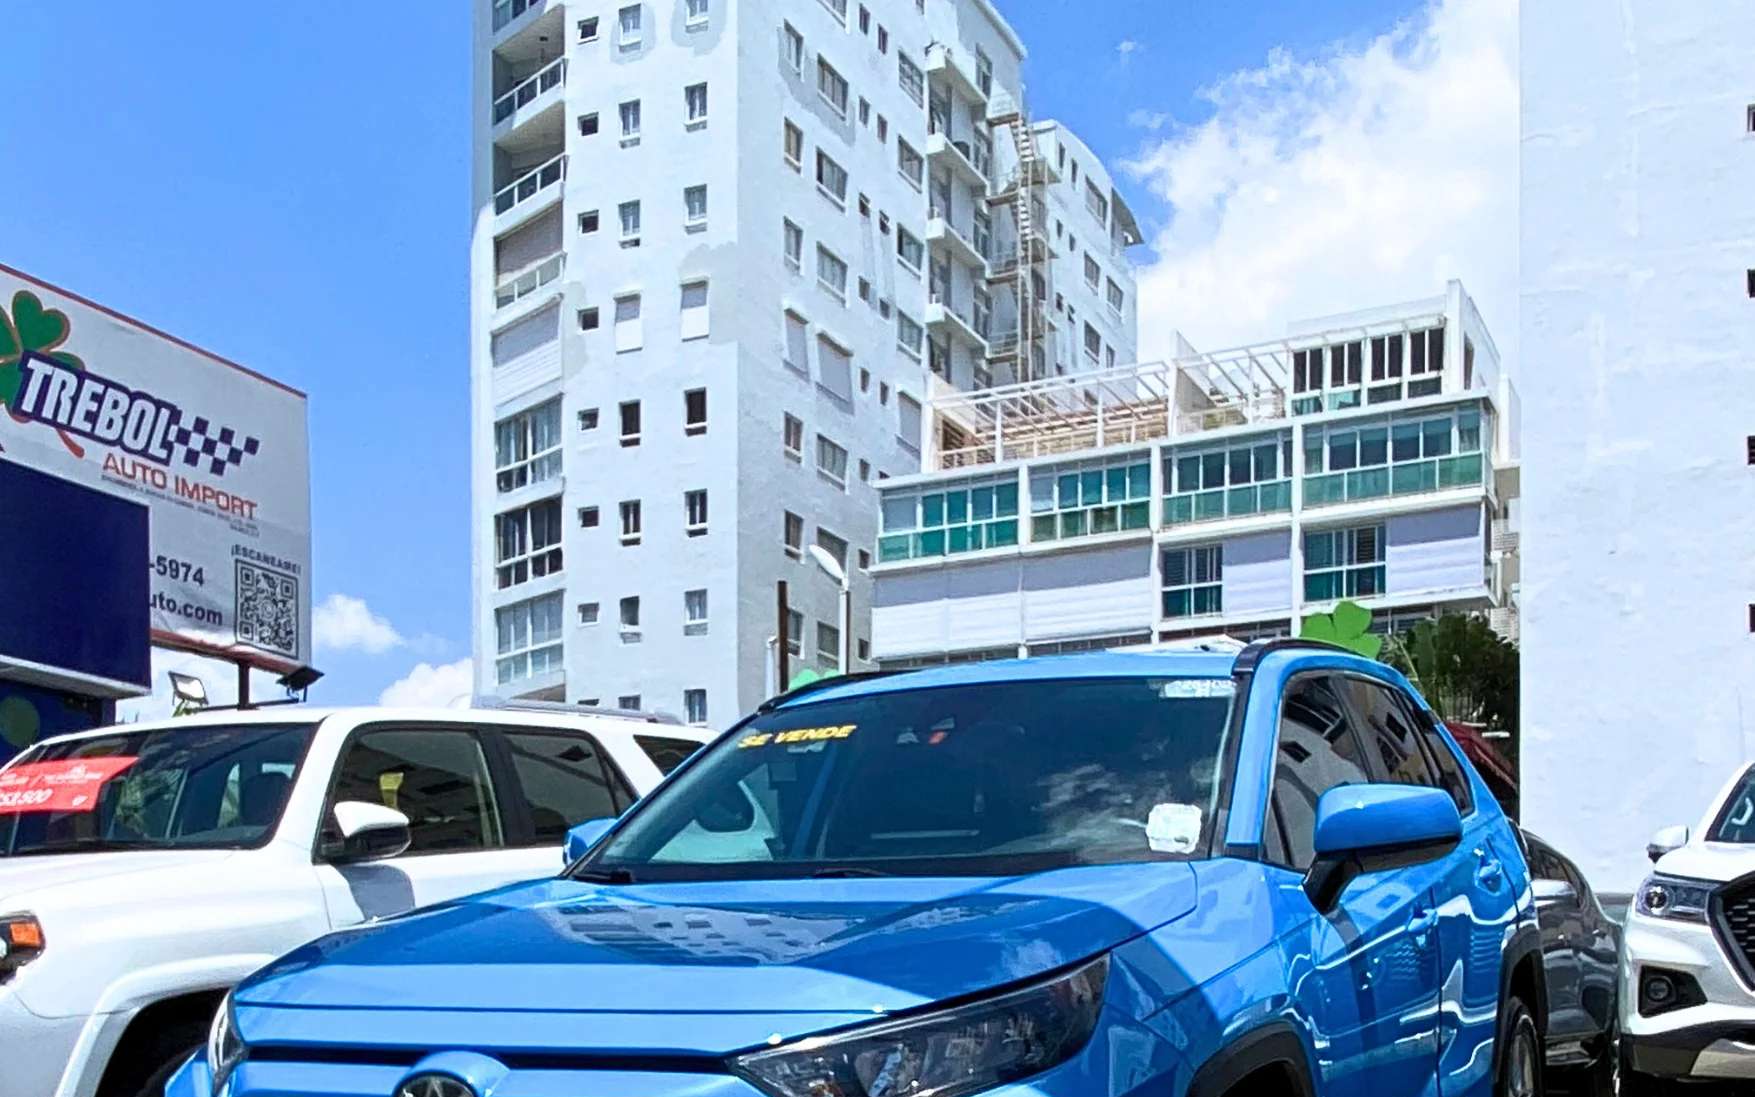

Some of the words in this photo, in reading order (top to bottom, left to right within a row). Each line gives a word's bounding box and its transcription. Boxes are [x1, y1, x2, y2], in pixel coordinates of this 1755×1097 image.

[20, 357, 172, 460] TREBOL
[103, 453, 167, 490] AUTO
[175, 474, 258, 521] IMPORT
[737, 733, 773, 749] SE
[774, 724, 858, 744] VENDE
